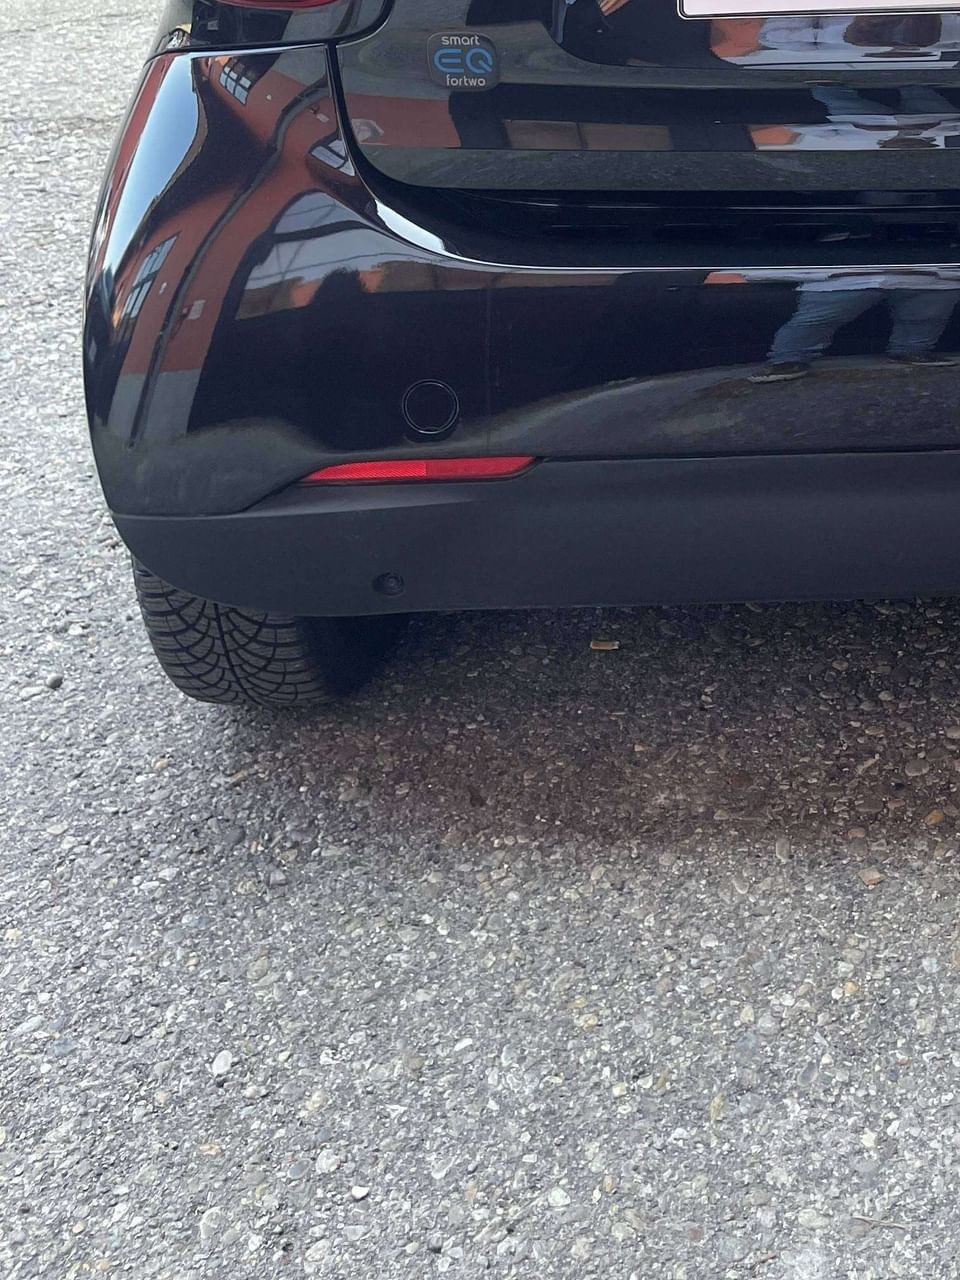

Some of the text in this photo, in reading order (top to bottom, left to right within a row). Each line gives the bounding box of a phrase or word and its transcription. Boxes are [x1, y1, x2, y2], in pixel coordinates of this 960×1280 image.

[441, 35, 480, 46] smart
[433, 47, 493, 74] EQ
[446, 74, 486, 87] fortwo
